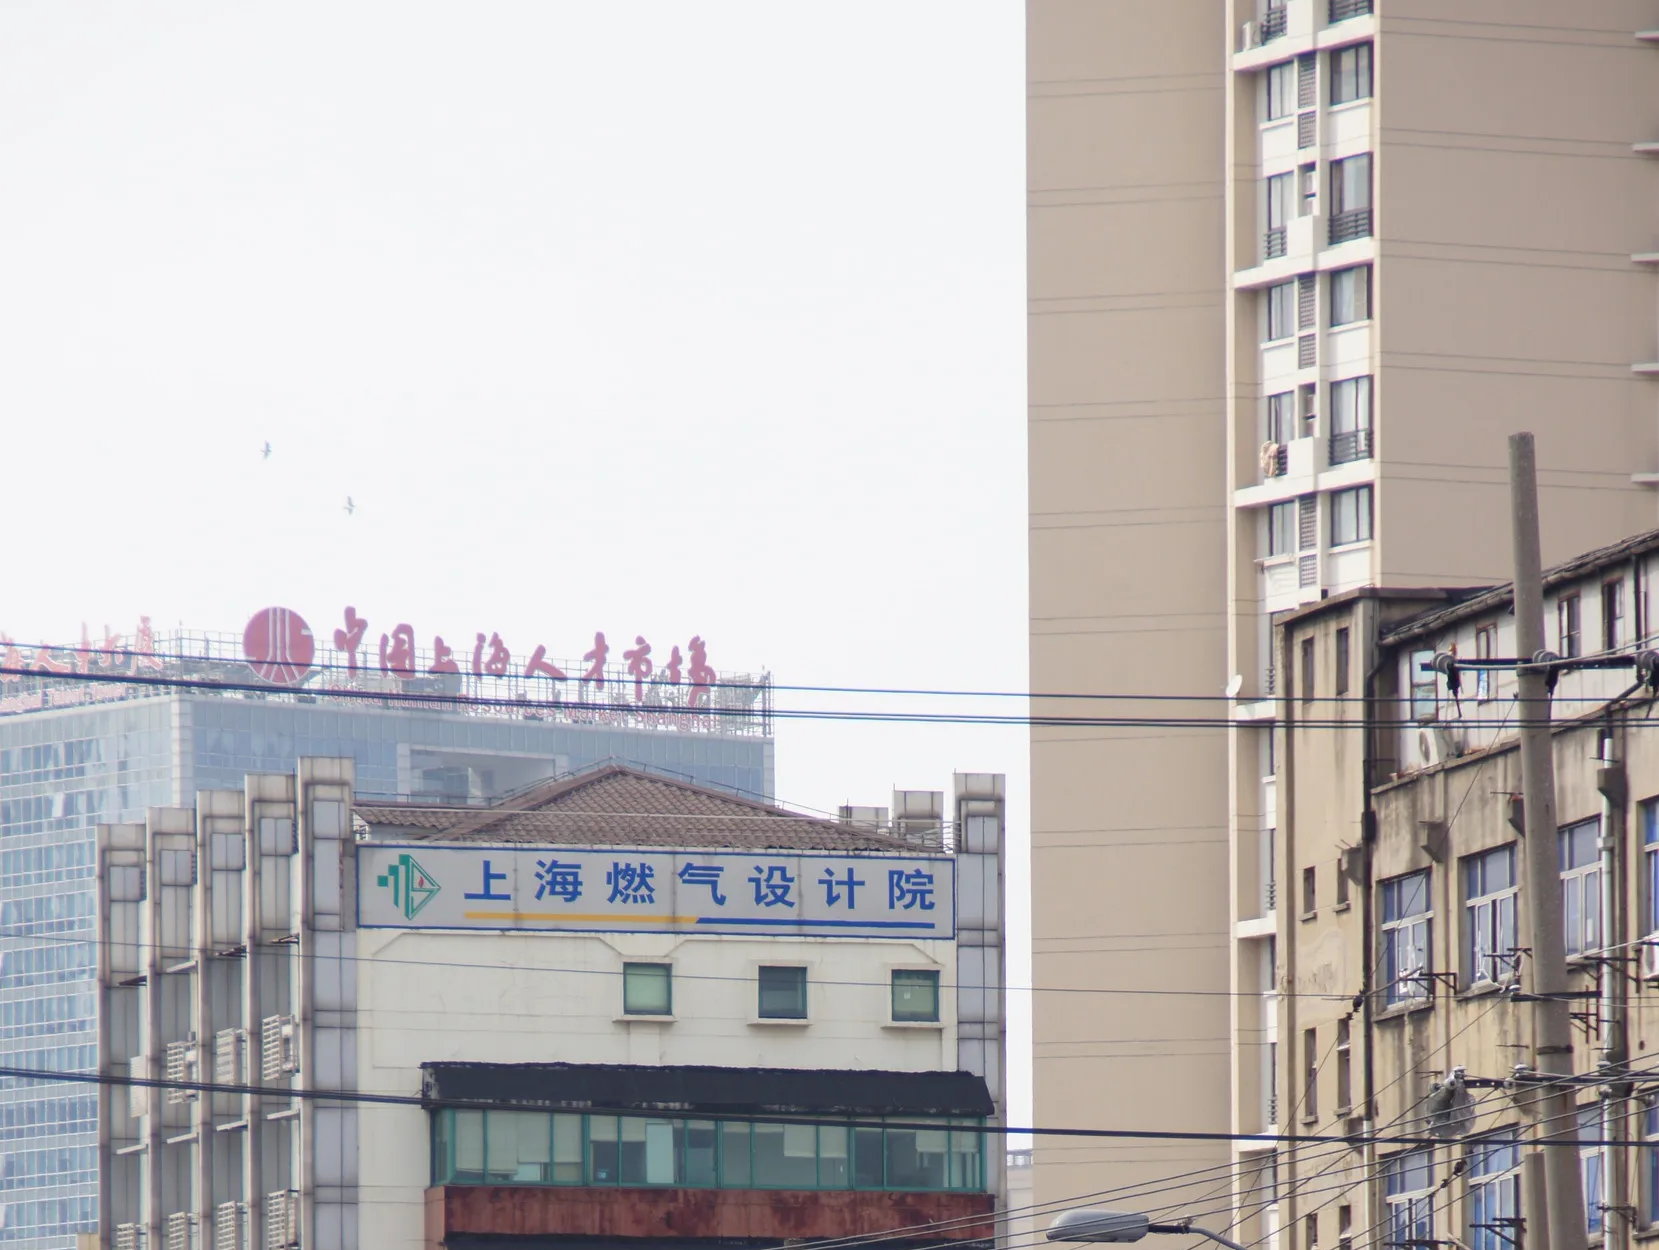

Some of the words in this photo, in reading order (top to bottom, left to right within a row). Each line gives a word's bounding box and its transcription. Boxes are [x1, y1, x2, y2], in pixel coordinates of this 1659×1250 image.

[464, 859, 936, 911] 上海燃气设计院
